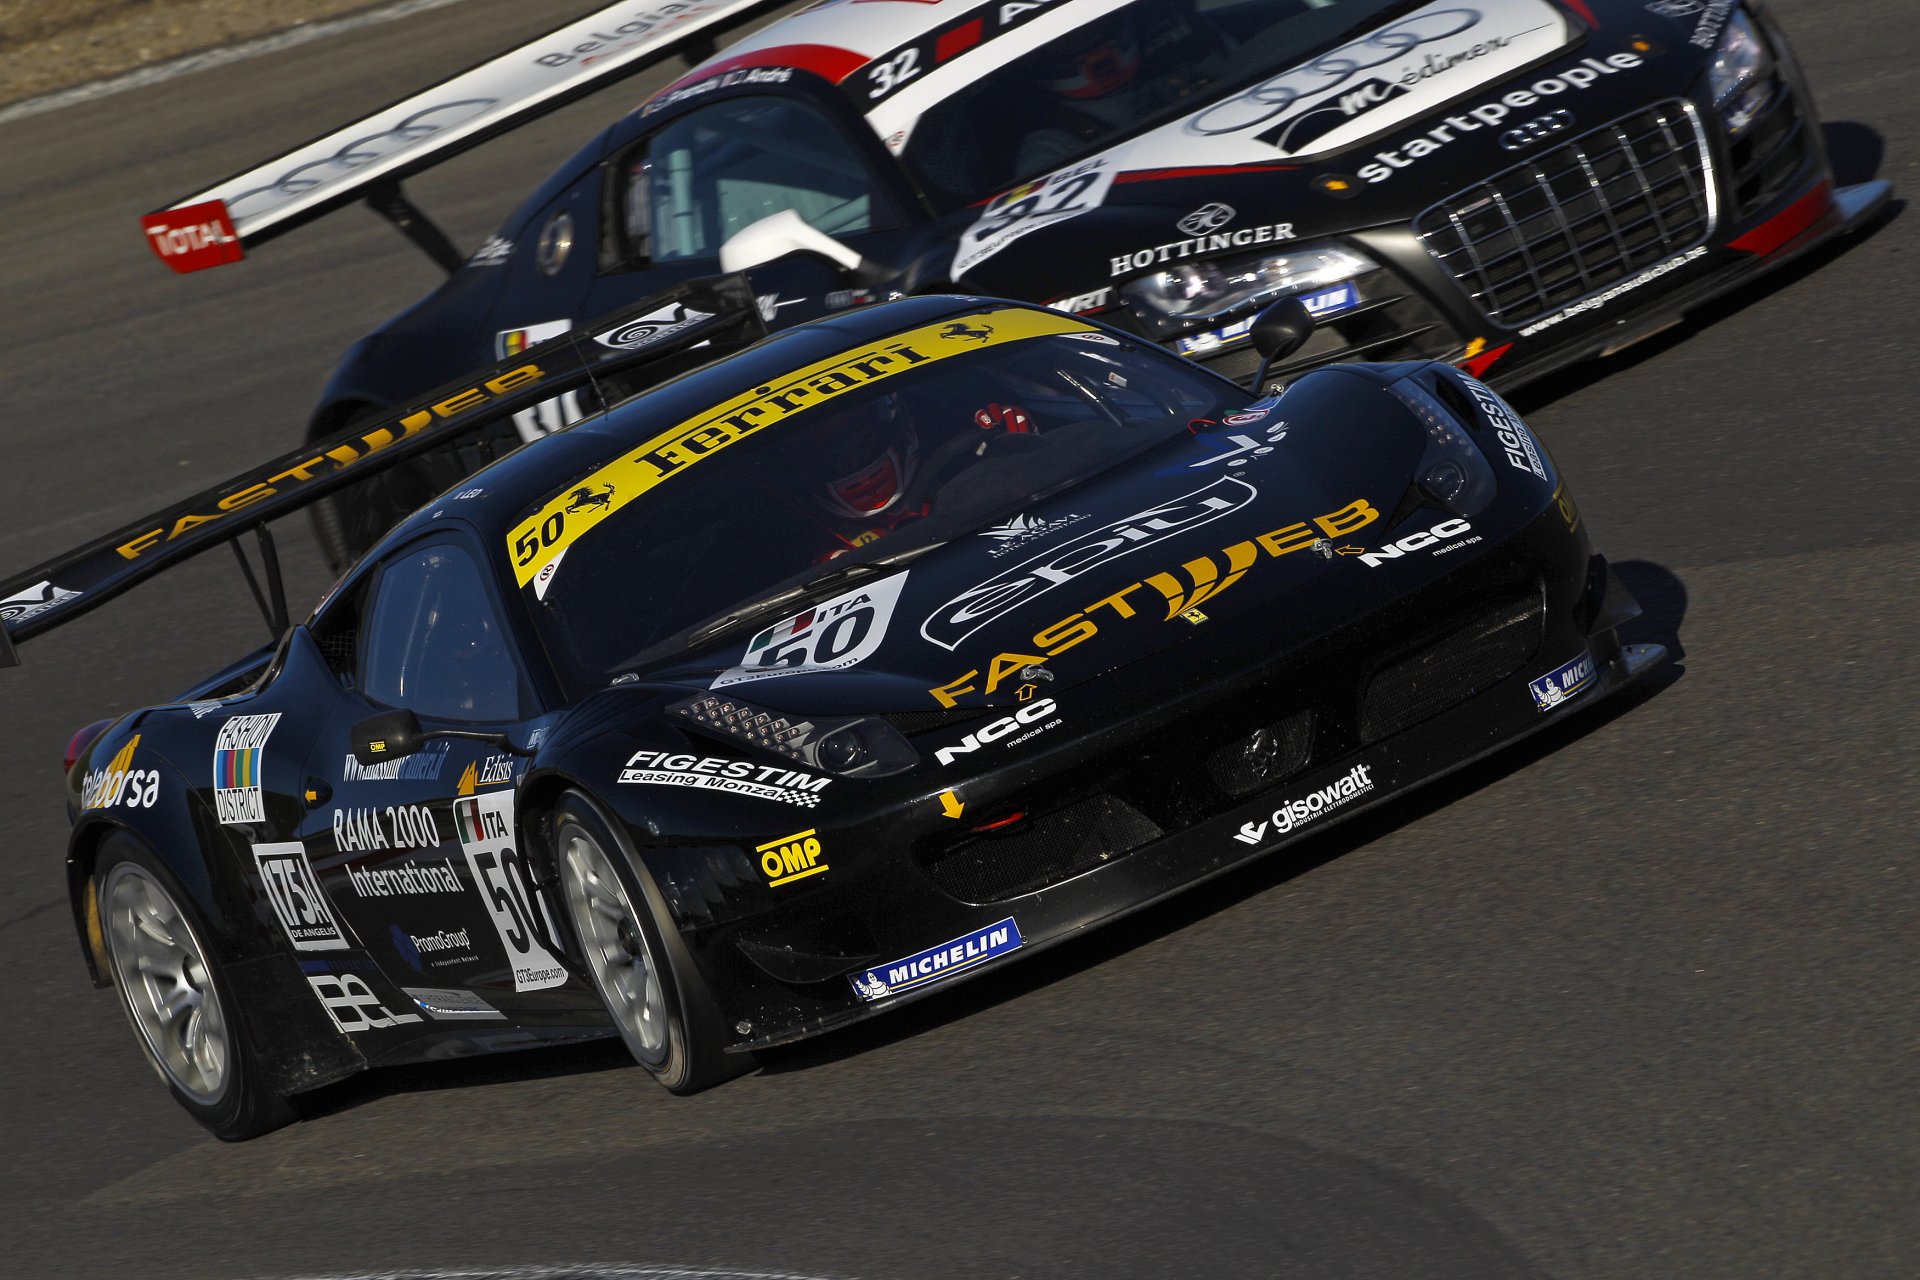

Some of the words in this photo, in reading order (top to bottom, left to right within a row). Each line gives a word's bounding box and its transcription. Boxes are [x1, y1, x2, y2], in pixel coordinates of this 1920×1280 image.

[535, 0, 705, 67] Belgia
[868, 47, 922, 99] 32
[1357, 53, 1643, 183] startpeople
[975, 171, 1102, 243] 32
[146, 219, 236, 257] TOTAL
[1109, 222, 1298, 277] HOTTINGER
[633, 342, 937, 484] Ferrari
[116, 364, 546, 561] FASTWEB
[515, 511, 564, 567] 50
[1431, 540, 1467, 557] medical
[1465, 535, 1484, 545] spa
[816, 593, 872, 624] ITA
[928, 498, 1381, 709] FASTWEB
[757, 606, 876, 671] 50
[720, 657, 859, 685] GT3Europe.com
[215, 714, 279, 750] FASHION
[370, 743, 386, 751] OMP
[1006, 726, 1044, 748] medical
[1044, 718, 1063, 731] spa
[620, 769, 699, 787] Leasing
[702, 776, 778, 799] Monza
[624, 749, 833, 793] FIGESTIM
[217, 786, 261, 821] DISTRICT
[1271, 763, 1372, 834] gisowatt
[1292, 810, 1323, 829] INDUSTRIA
[1322, 783, 1375, 814] ELETTRODOMESTICI
[333, 807, 390, 852] RAMA
[385, 804, 440, 849] 2000
[481, 810, 509, 840] ITA
[344, 856, 465, 898] International
[760, 836, 823, 880] OMP
[472, 847, 548, 955] 50
[291, 928, 305, 938] DE
[303, 926, 337, 937] ANGELIS
[410, 928, 471, 953] PromoGroup
[516, 967, 565, 984] GT3Europe.com
[888, 926, 1009, 985] MICHELIN
